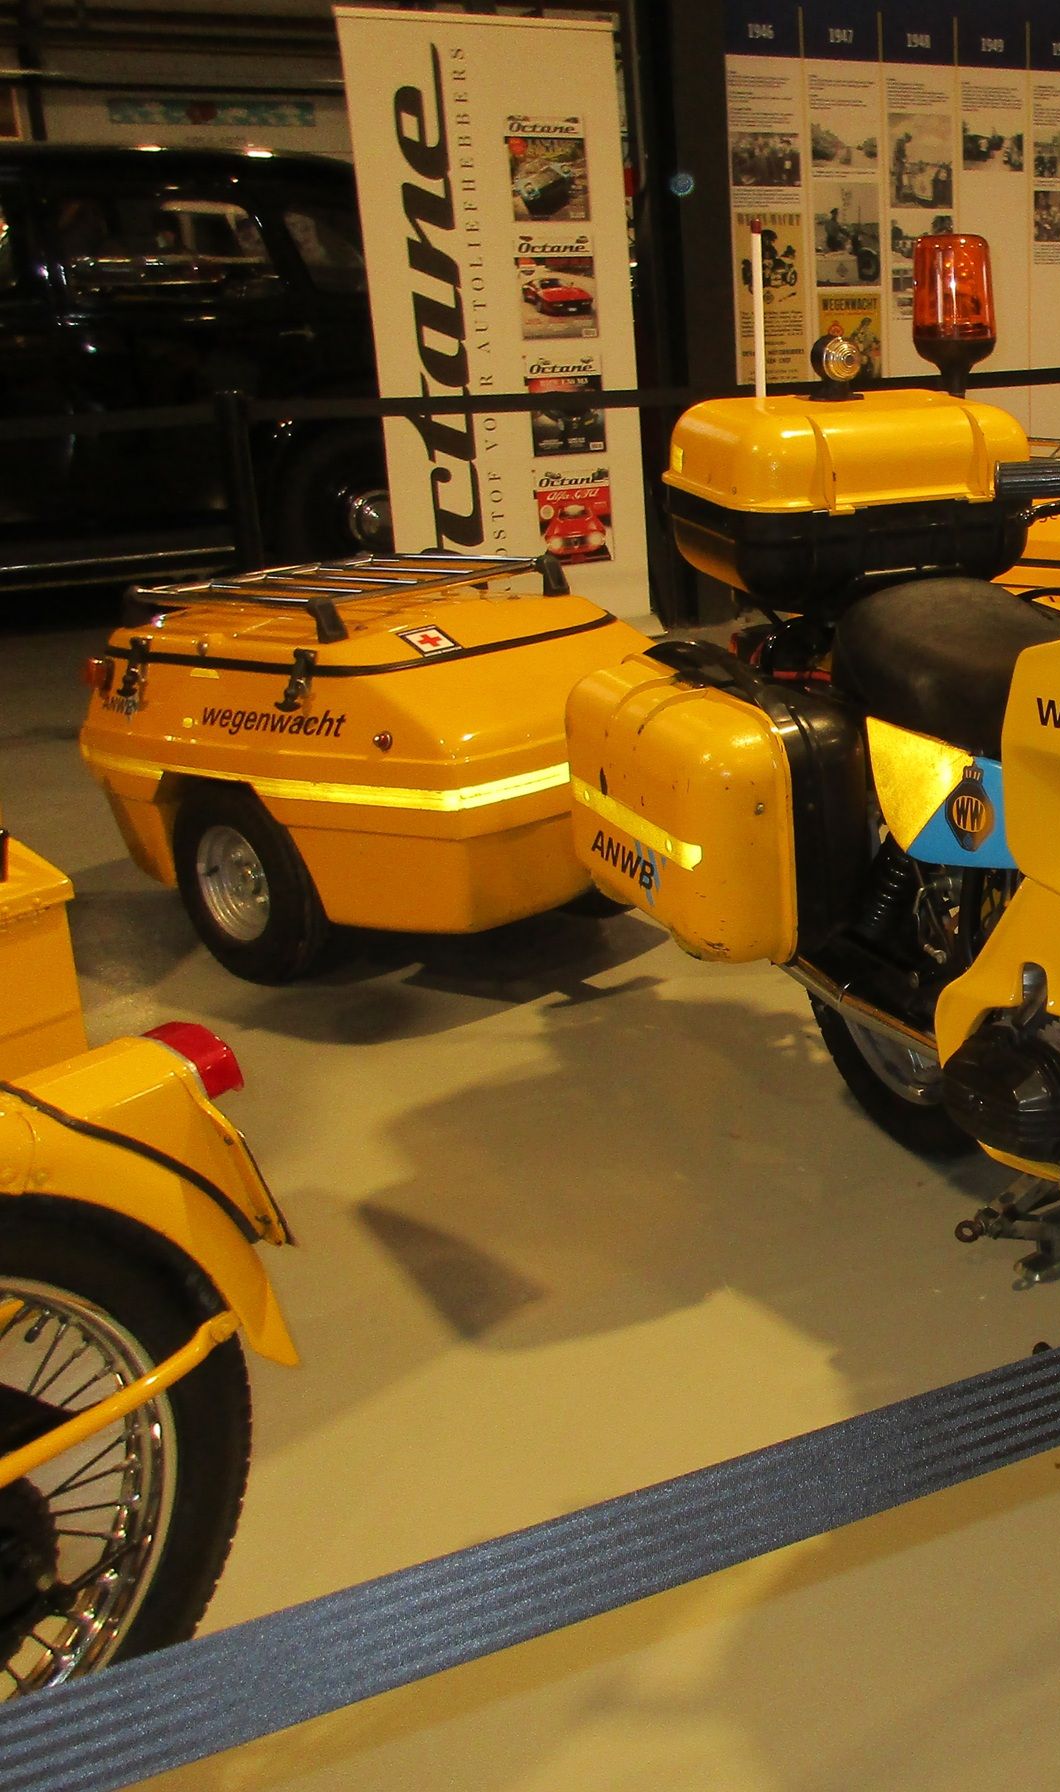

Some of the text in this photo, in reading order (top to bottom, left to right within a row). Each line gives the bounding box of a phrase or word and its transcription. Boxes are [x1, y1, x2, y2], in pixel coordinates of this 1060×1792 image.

[748, 23, 775, 39] 1946
[829, 28, 854, 44] 1947
[907, 33, 931, 48] 1948
[981, 38, 1005, 53] 1949
[509, 122, 577, 134] Octane
[451, 48, 491, 353] AUTOLIEFHEBBERS
[518, 242, 589, 254] Octane
[394, 42, 485, 560] ctane
[822, 298, 877, 311] WEGENWACHT
[529, 363, 596, 375] Octane
[480, 374, 498, 450] VOR
[202, 706, 346, 738] wegenwacht
[592, 829, 655, 890] ANWB
